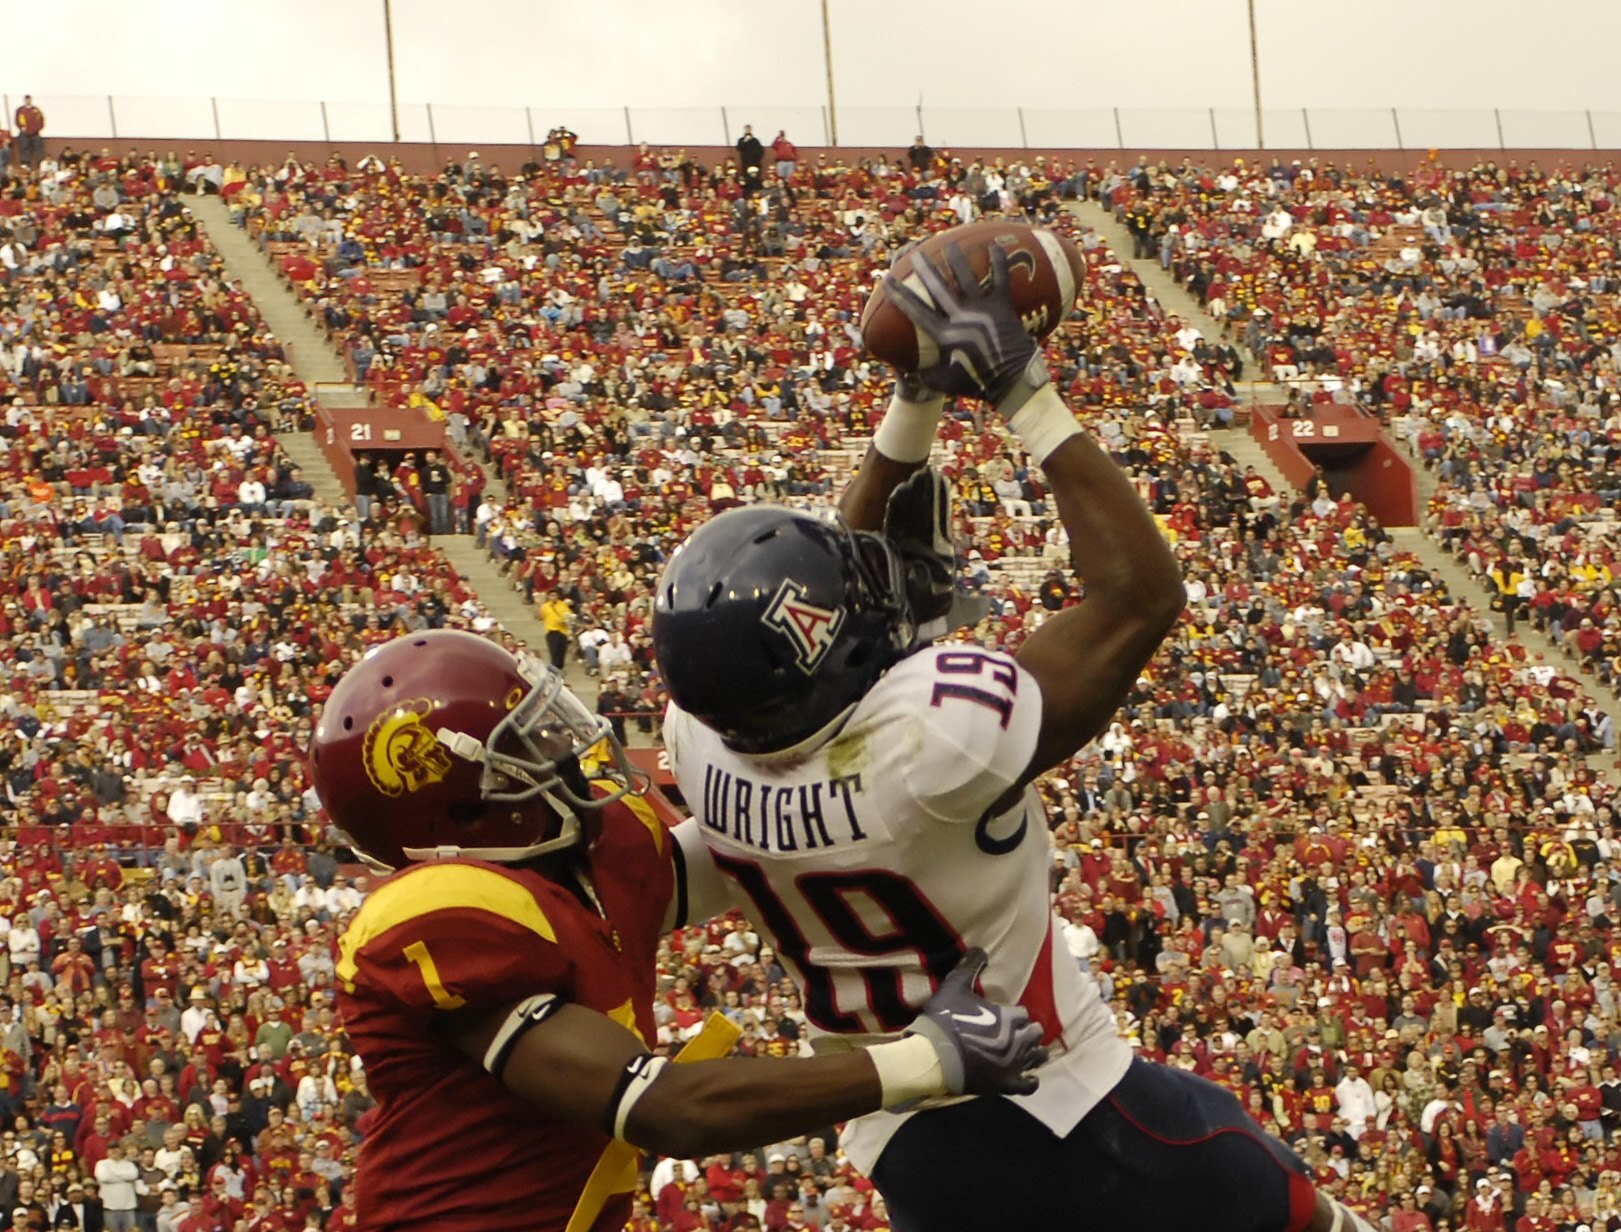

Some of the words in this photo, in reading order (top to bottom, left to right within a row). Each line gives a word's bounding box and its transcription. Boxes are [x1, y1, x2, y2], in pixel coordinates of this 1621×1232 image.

[351, 423, 372, 440] 21
[1292, 420, 1315, 437] 22
[761, 578, 847, 676] A
[930, 652, 1018, 732] 19
[703, 764, 868, 851] WRIGHT
[402, 940, 467, 1010] 1
